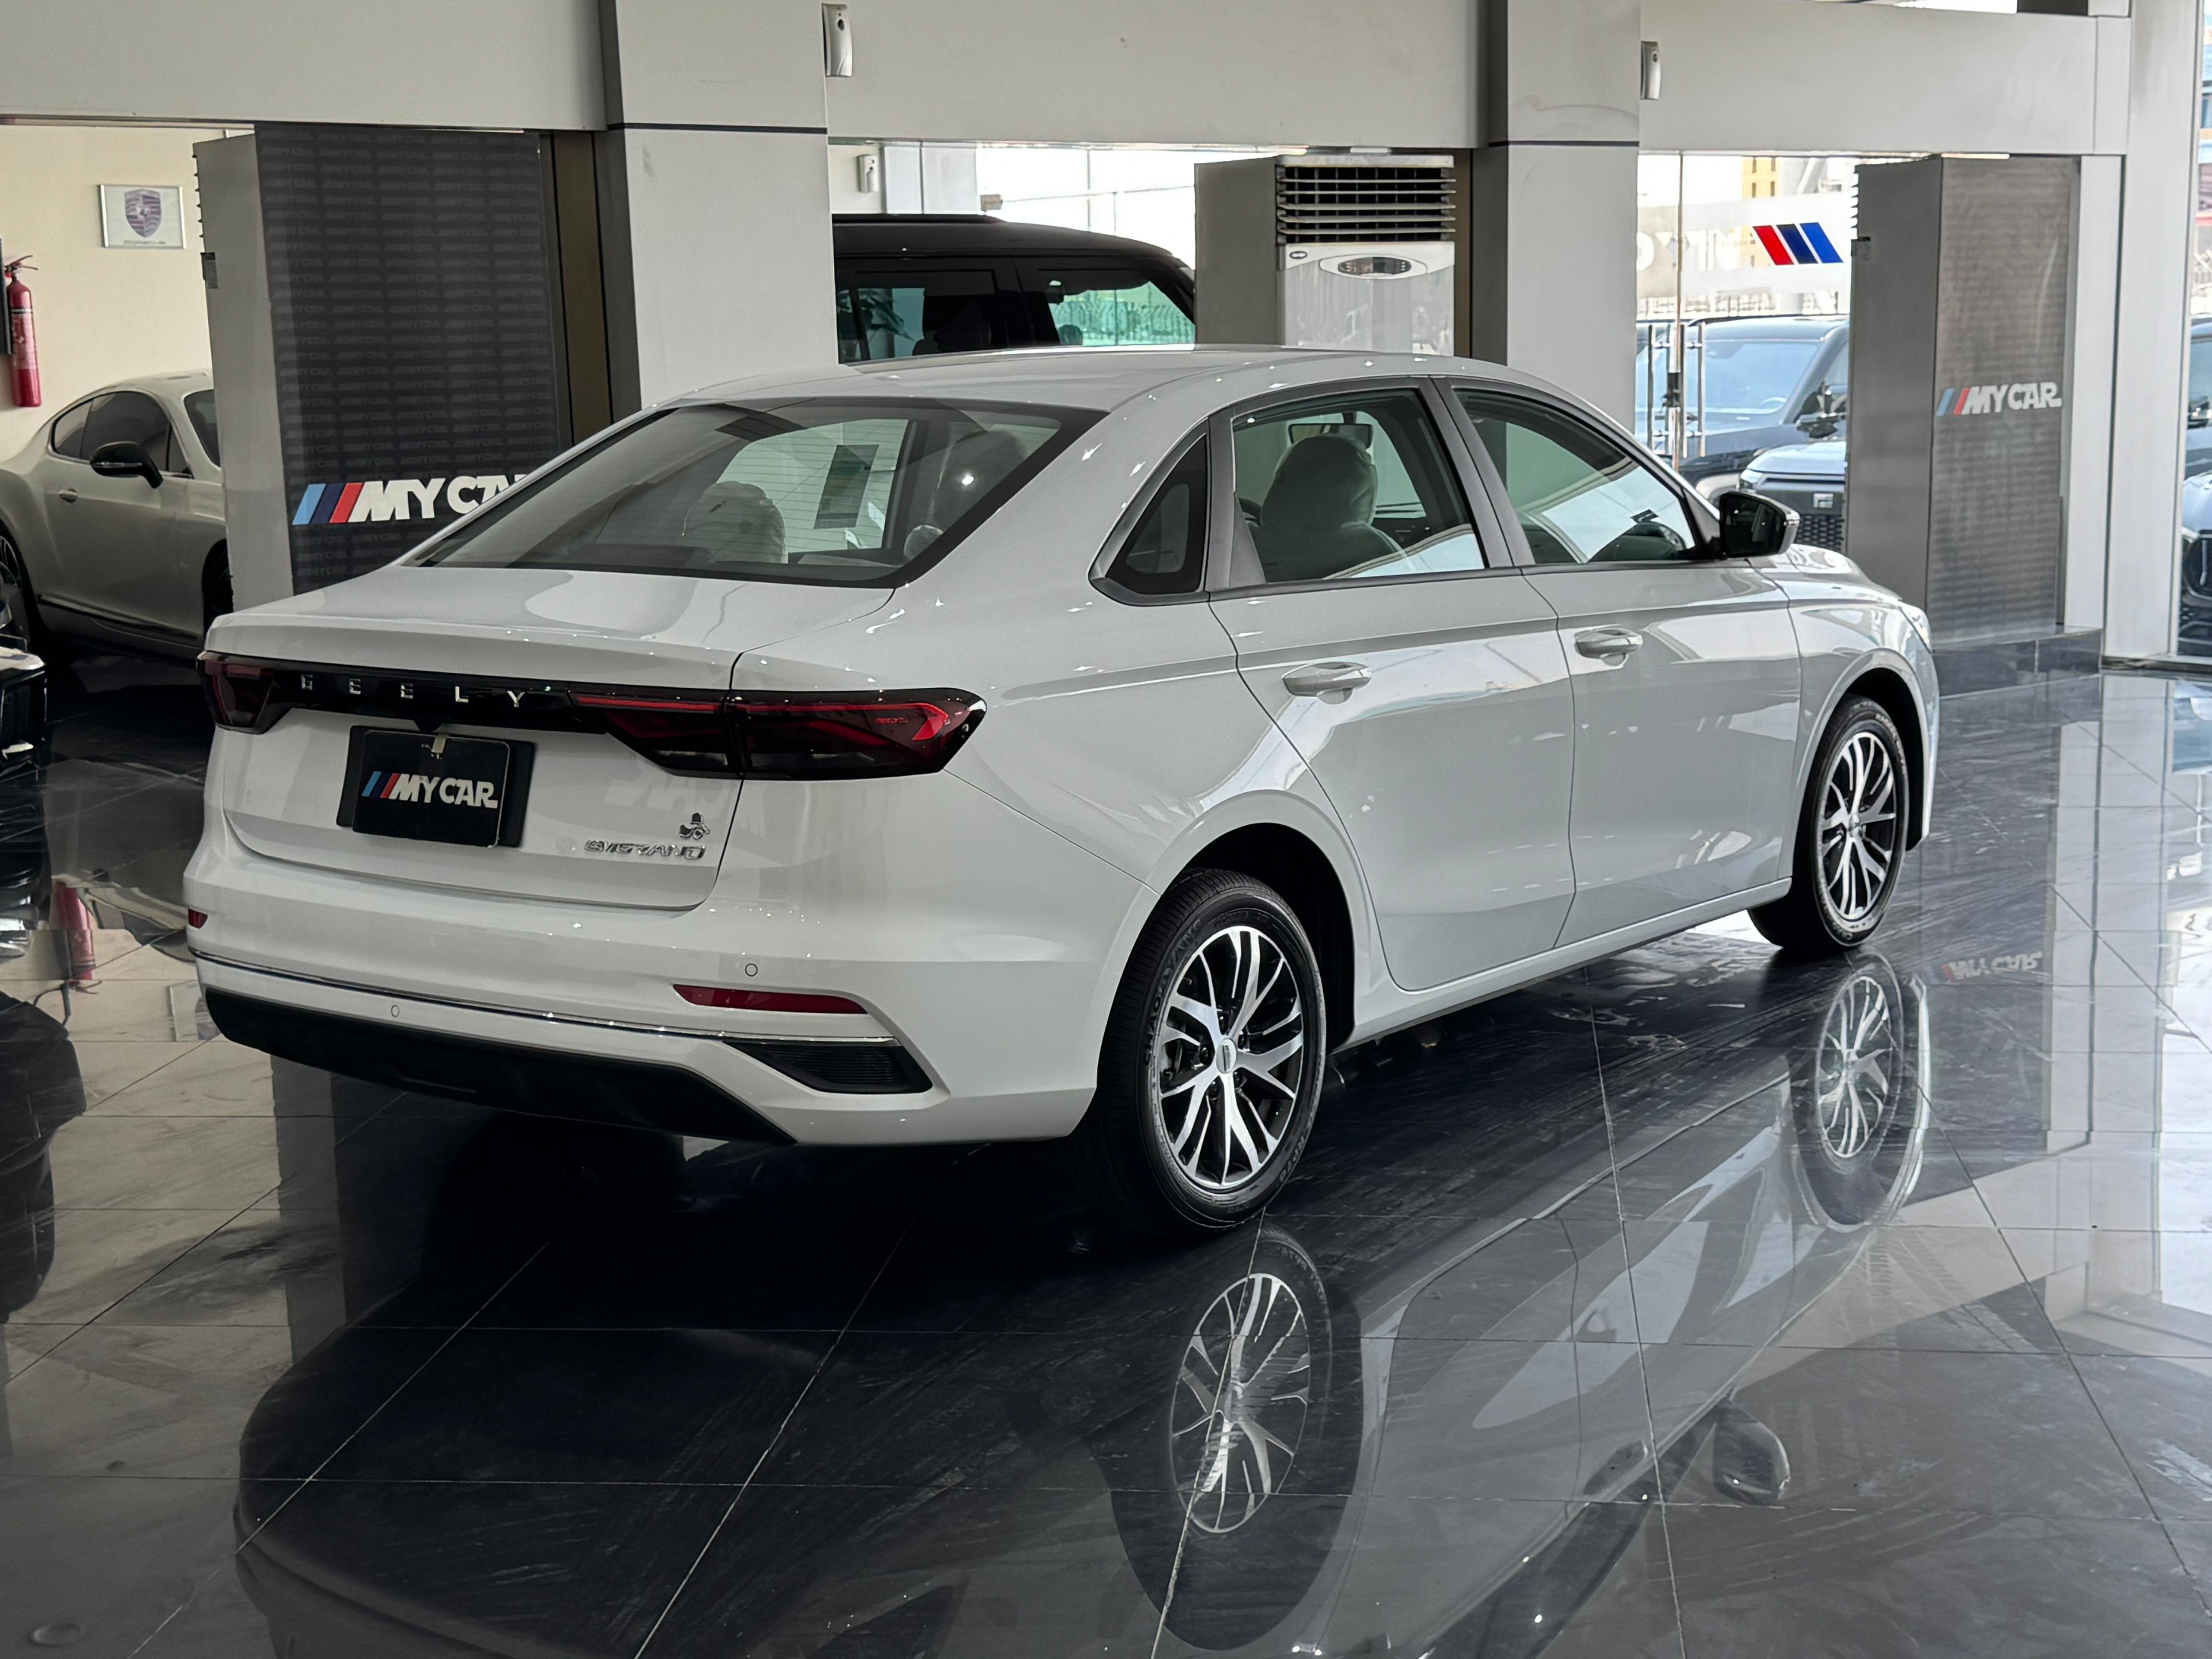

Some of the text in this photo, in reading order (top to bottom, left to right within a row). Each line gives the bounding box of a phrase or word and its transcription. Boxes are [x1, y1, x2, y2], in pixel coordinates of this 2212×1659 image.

[2007, 381, 2062, 410] CAR
[300, 673, 527, 708] GEELY
[439, 777, 498, 809] CAR
